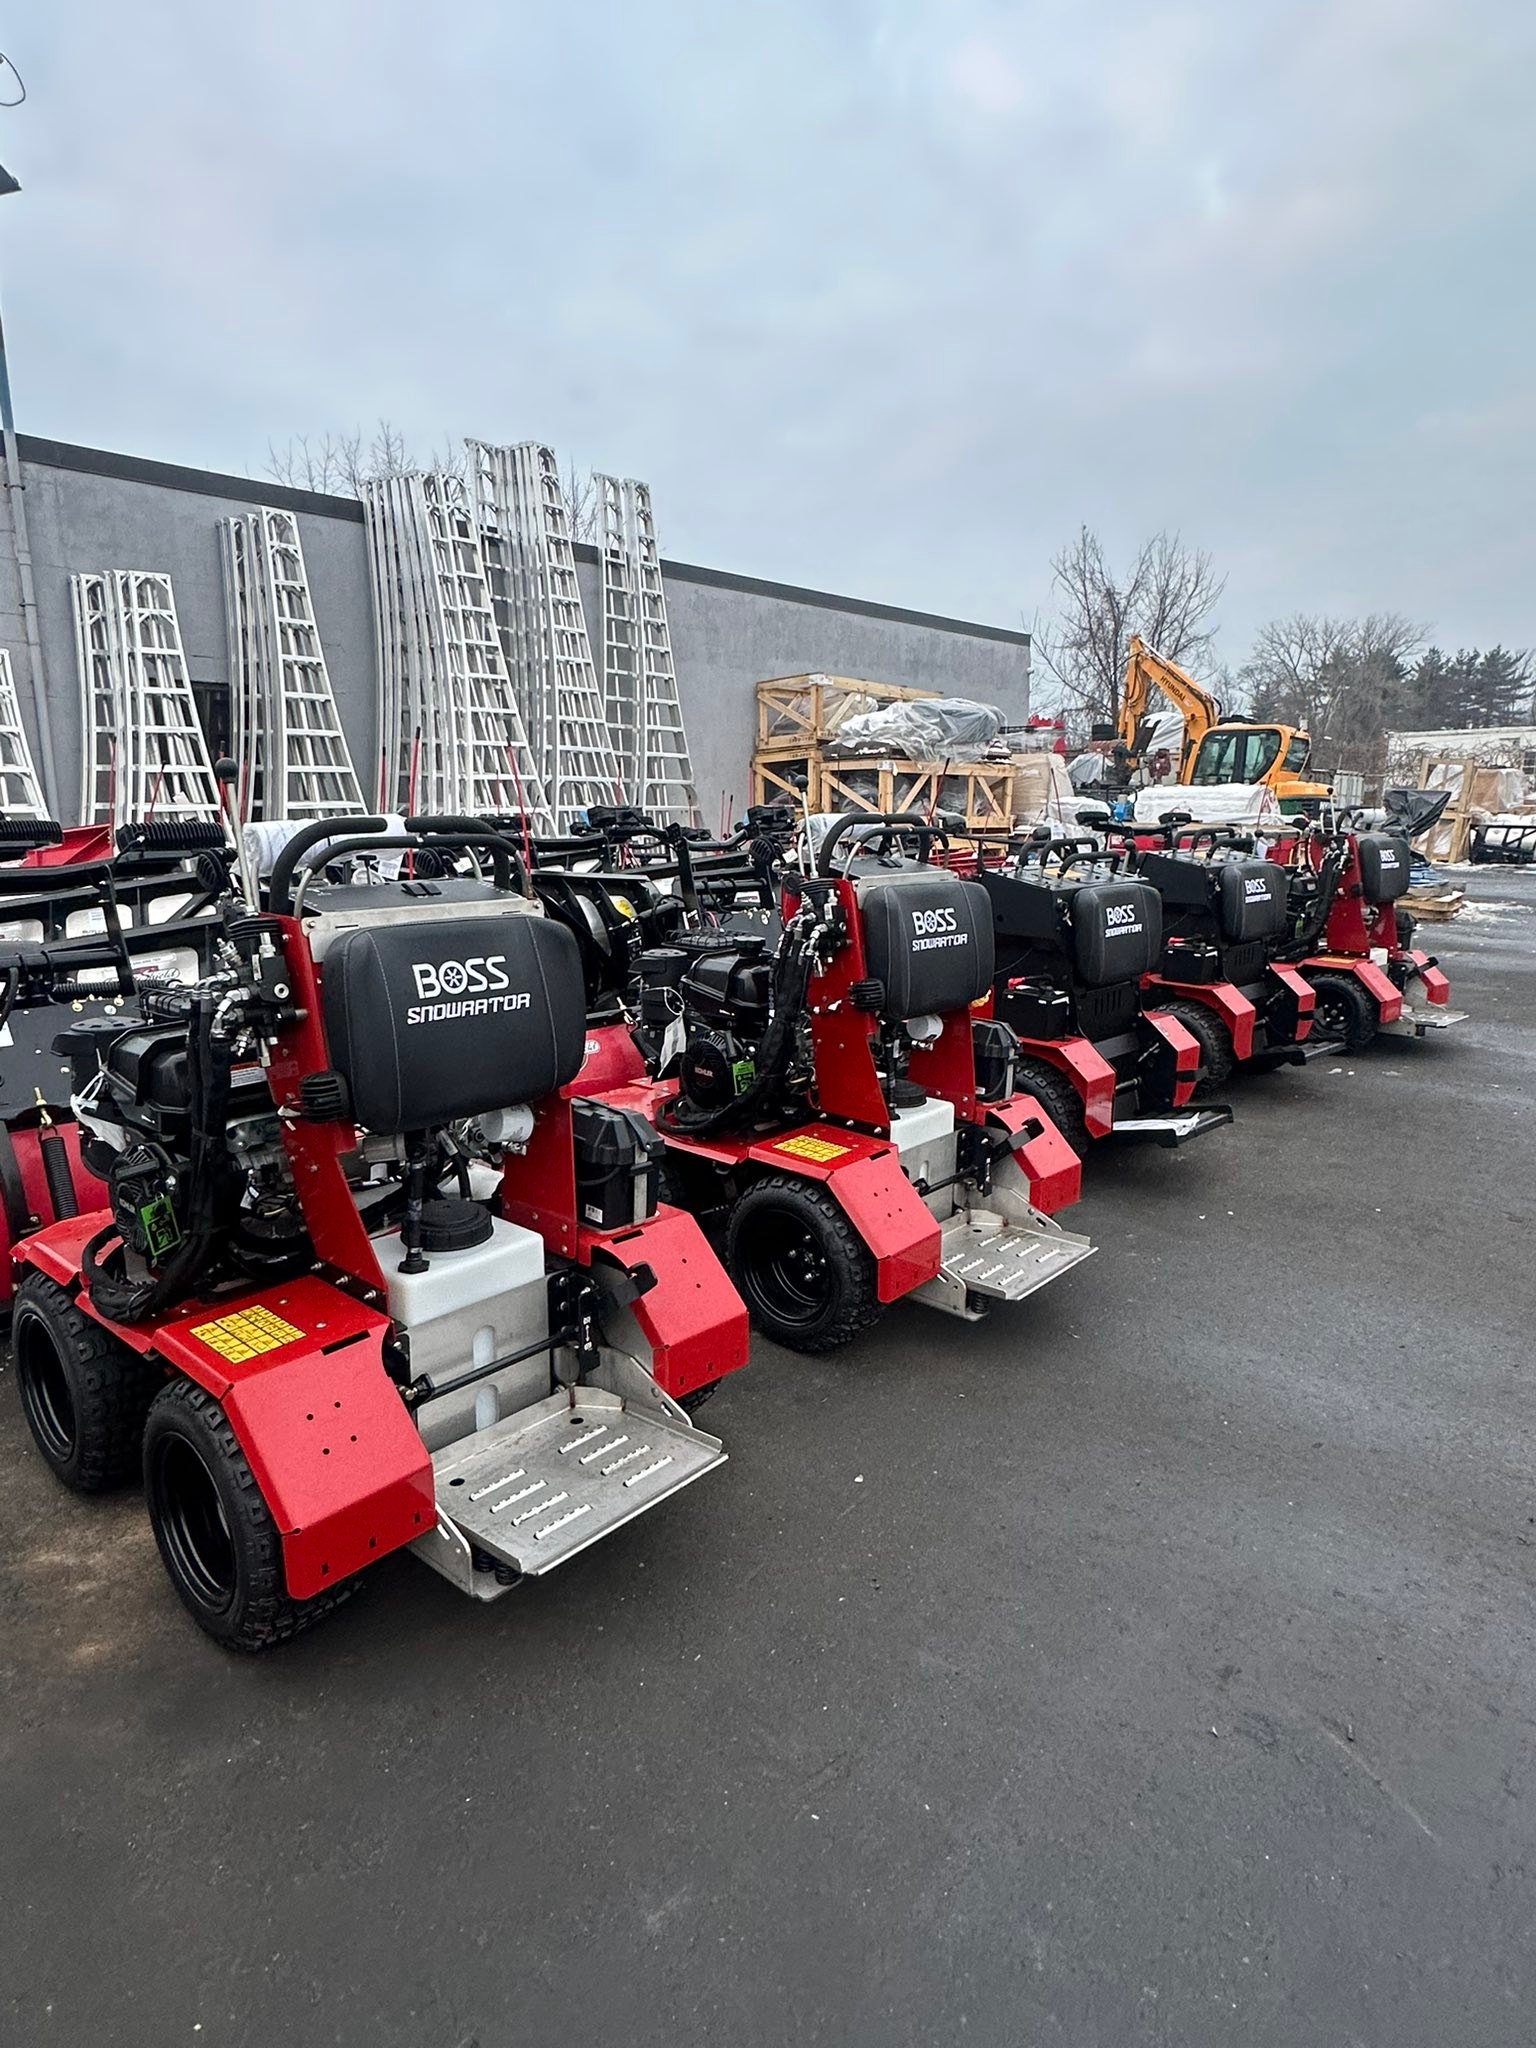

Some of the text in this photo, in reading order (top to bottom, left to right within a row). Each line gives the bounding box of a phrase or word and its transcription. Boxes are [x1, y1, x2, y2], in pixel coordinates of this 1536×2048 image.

[1160, 675, 1187, 702] HYUNDAI
[1244, 878, 1267, 895] BOSS
[911, 907, 957, 936] BOSS
[1105, 904, 1136, 926] BOSS
[411, 955, 510, 1000] BOSS
[406, 992, 531, 1025] SNOWRATOR
